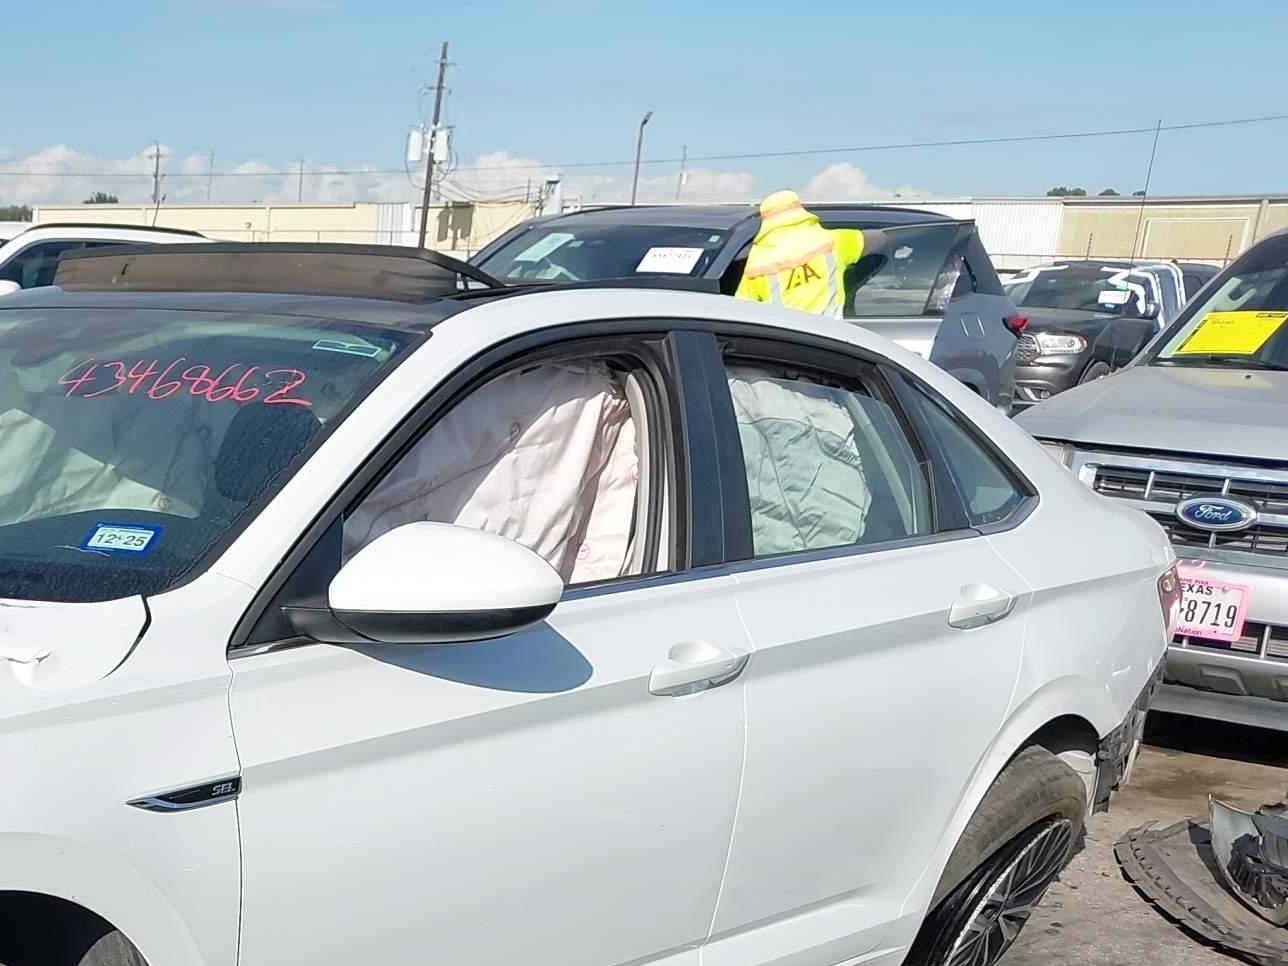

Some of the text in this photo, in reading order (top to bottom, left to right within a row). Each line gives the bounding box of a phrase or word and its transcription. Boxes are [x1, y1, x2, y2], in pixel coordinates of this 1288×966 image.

[58, 357, 313, 407] 43468662
[1194, 504, 1233, 521] Ford
[96, 533, 148, 547] 12 25
[1179, 582, 1214, 596] EXAS
[212, 783, 236, 796] SEL
